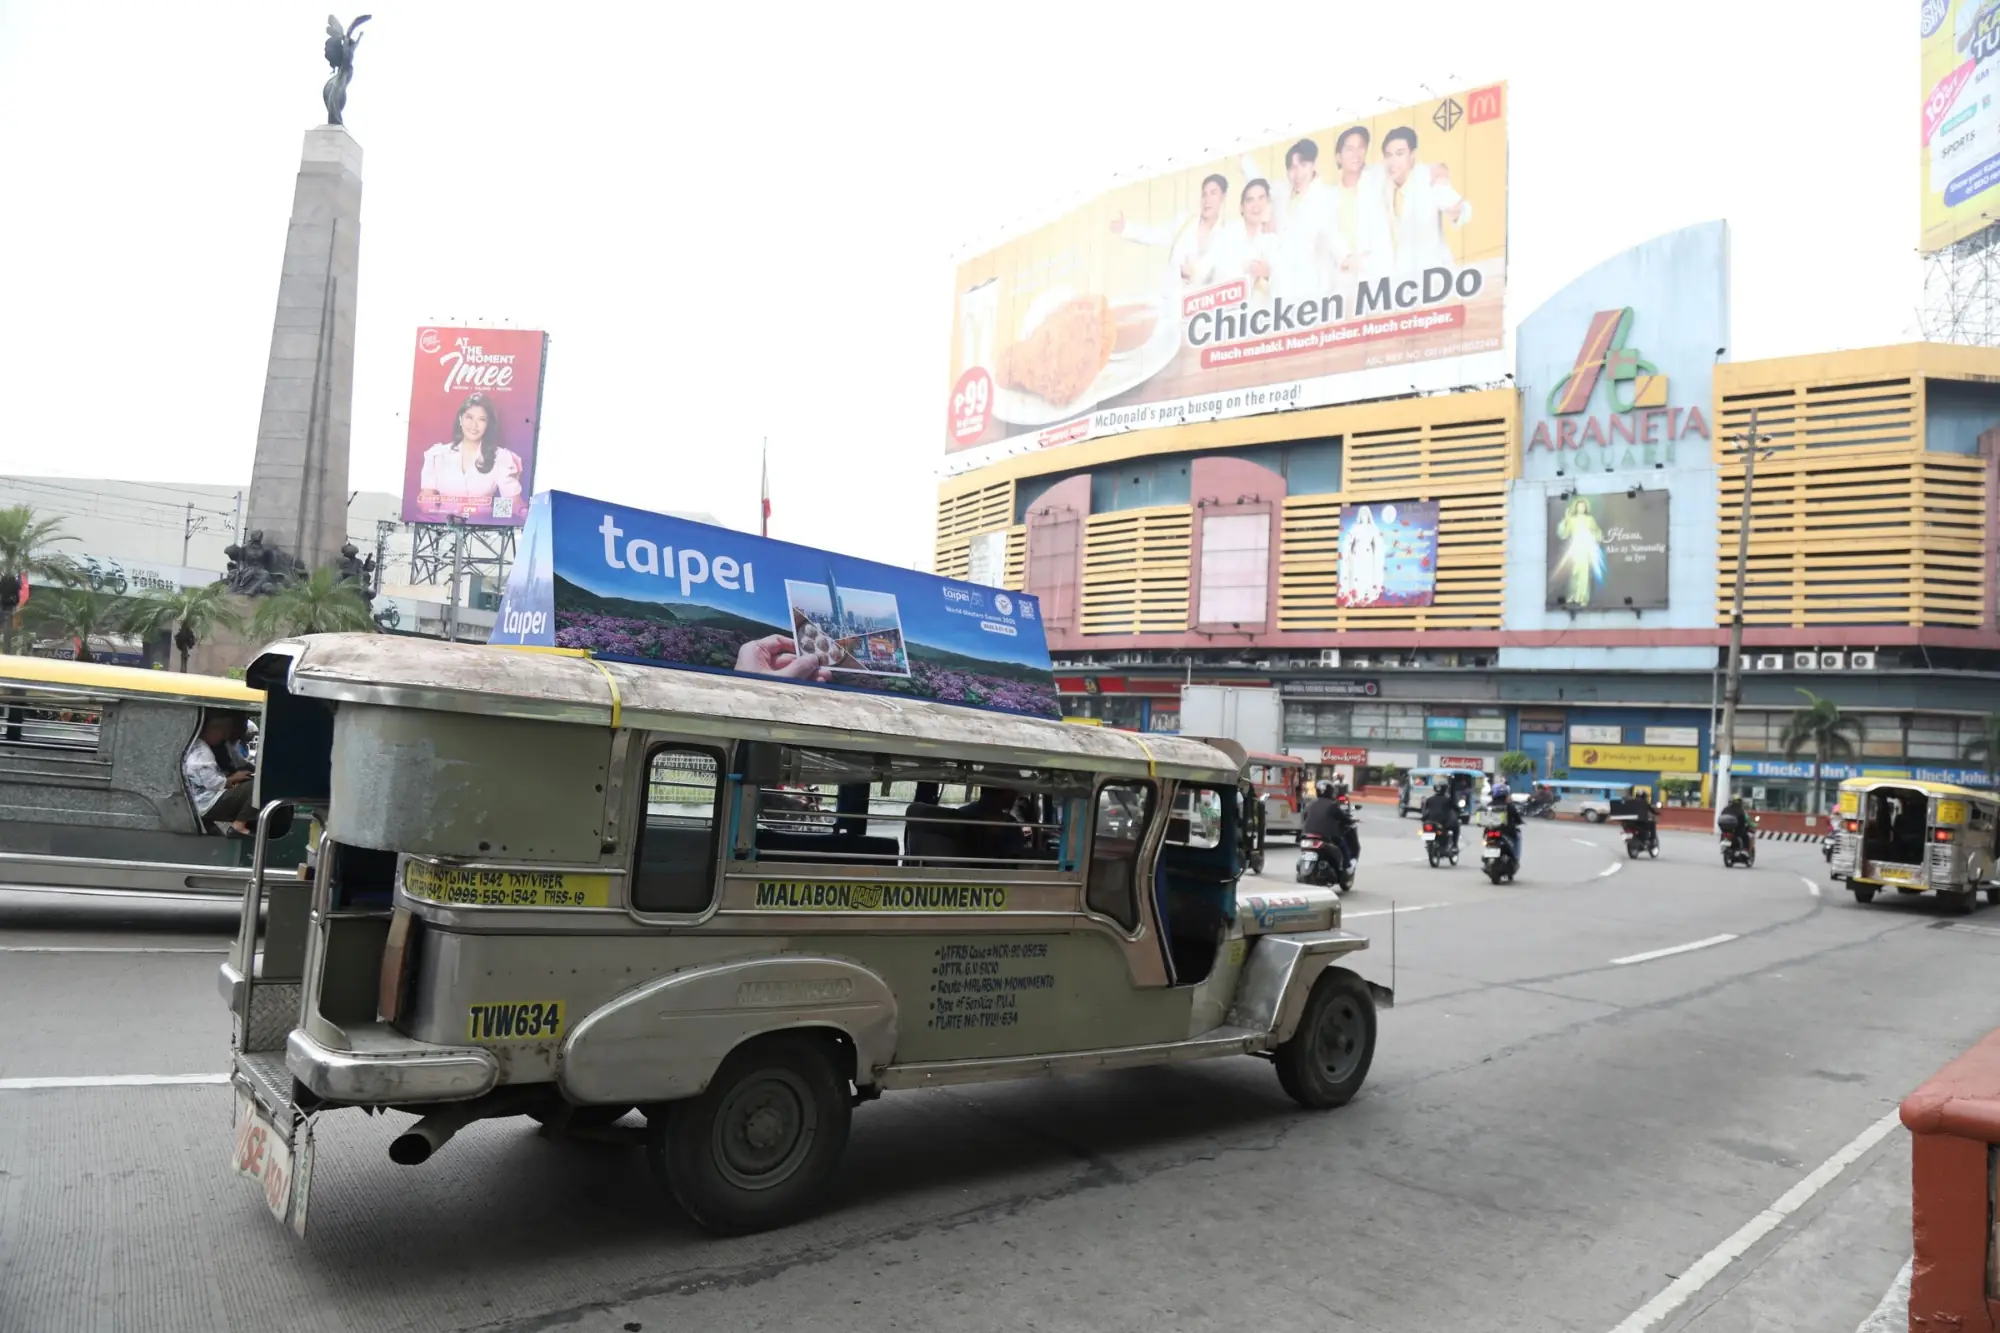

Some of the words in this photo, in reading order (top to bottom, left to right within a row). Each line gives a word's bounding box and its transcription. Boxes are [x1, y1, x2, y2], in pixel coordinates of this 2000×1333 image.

[1941, 129, 1976, 159] SPORTS
[1188, 294, 1344, 346] Chicken
[1354, 266, 1483, 317] McDo
[455, 336, 470, 347] AT
[461, 346, 483, 355] THE
[1210, 347, 1242, 362] Much
[1286, 337, 1318, 352] Much
[1362, 322, 1399, 337] Much
[1400, 313, 1454, 332] crispier.
[466, 355, 515, 365] MOMENT
[1095, 406, 1156, 429] McDonald's
[1159, 403, 1185, 423] para
[1188, 398, 1223, 416] busog
[1226, 396, 1241, 409] on
[1245, 391, 1265, 406] the
[1269, 384, 1302, 405] road!
[1527, 406, 1712, 453] ARANETA
[598, 514, 755, 597] taipei
[942, 584, 970, 603] taipei
[504, 599, 548, 645] taipei
[1757, 763, 1802, 777] Uncle
[1803, 763, 1858, 779] Jhn's
[1916, 767, 1955, 783] Uncle
[756, 882, 850, 907] MALABON
[882, 885, 1005, 909] MONUMENTO
[470, 1003, 560, 1039] TVW634
